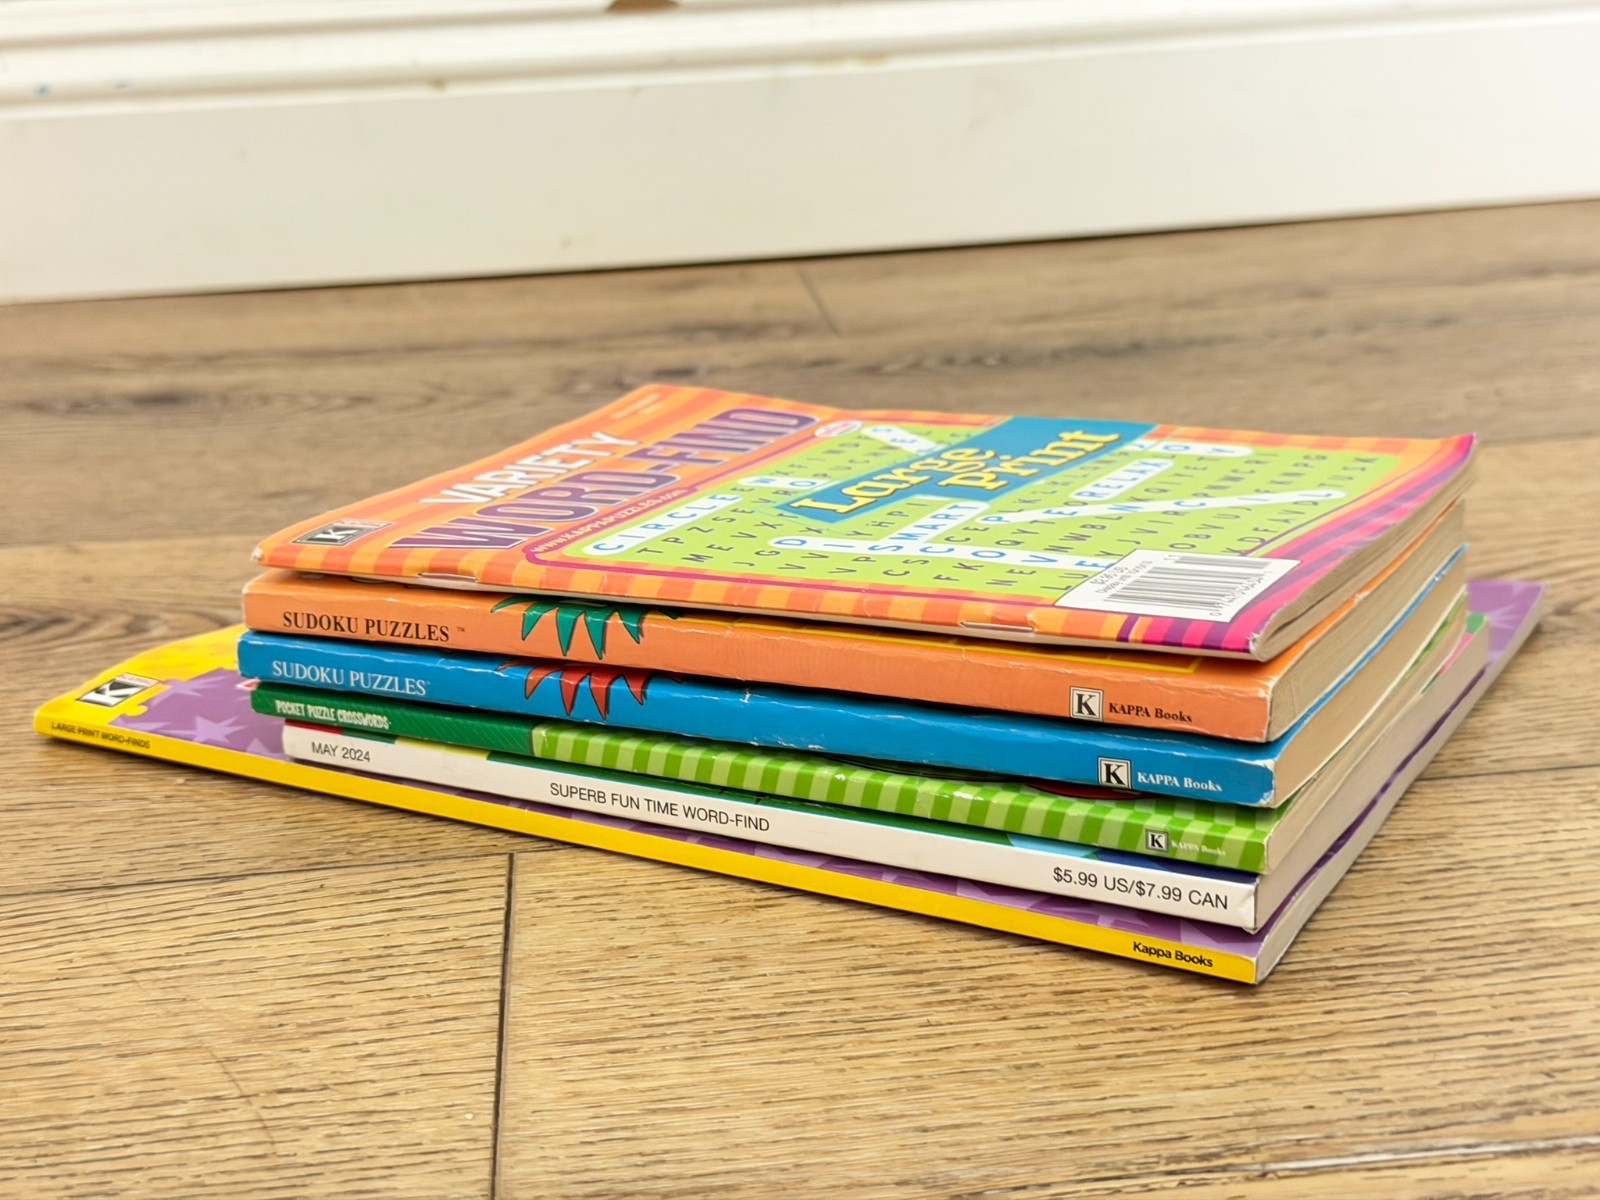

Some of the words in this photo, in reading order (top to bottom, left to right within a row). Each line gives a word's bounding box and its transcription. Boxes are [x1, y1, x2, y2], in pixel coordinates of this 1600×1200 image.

[419, 430, 641, 504] VARIETY
[937, 428, 1121, 492] Print
[386, 407, 821, 549] WORD-FIND
[788, 447, 997, 515] Large
[1074, 459, 1167, 499] RELAX
[592, 494, 740, 551] CIRCLE
[866, 504, 979, 552] SMART
[283, 611, 359, 634] SUDOKU
[365, 619, 450, 642] PUZZLES
[272, 660, 345, 685] SUDOKU
[350, 675, 426, 697] PUZZLES
[275, 699, 305, 717] POCKET
[307, 704, 336, 722] PUZZLE
[337, 708, 390, 730] CROSSWORDS
[1075, 693, 1097, 716] K
[1108, 702, 1151, 718] KAPPA
[1154, 708, 1192, 723] Books
[51, 721, 77, 735] LARGE
[78, 727, 100, 738] PRINT
[101, 730, 151, 749] WORD-FINDS
[312, 742, 338, 757] MAY
[342, 746, 371, 762] 2024
[1104, 763, 1125, 786] K
[1137, 771, 1180, 787] KAPPA
[1184, 777, 1223, 792] Books
[550, 782, 607, 804] SUPERB
[611, 793, 640, 810] FUN
[644, 798, 679, 817] TIME
[682, 805, 770, 832] WORD-FIND
[1150, 833, 1163, 848] K
[1171, 840, 1200, 852] KAPPA
[1053, 866, 1098, 888] $5.99
[1103, 874, 1182, 902] US/$7.99
[1188, 890, 1228, 910] CAN
[1133, 941, 1172, 959] Kappa
[1175, 950, 1213, 968] Books
